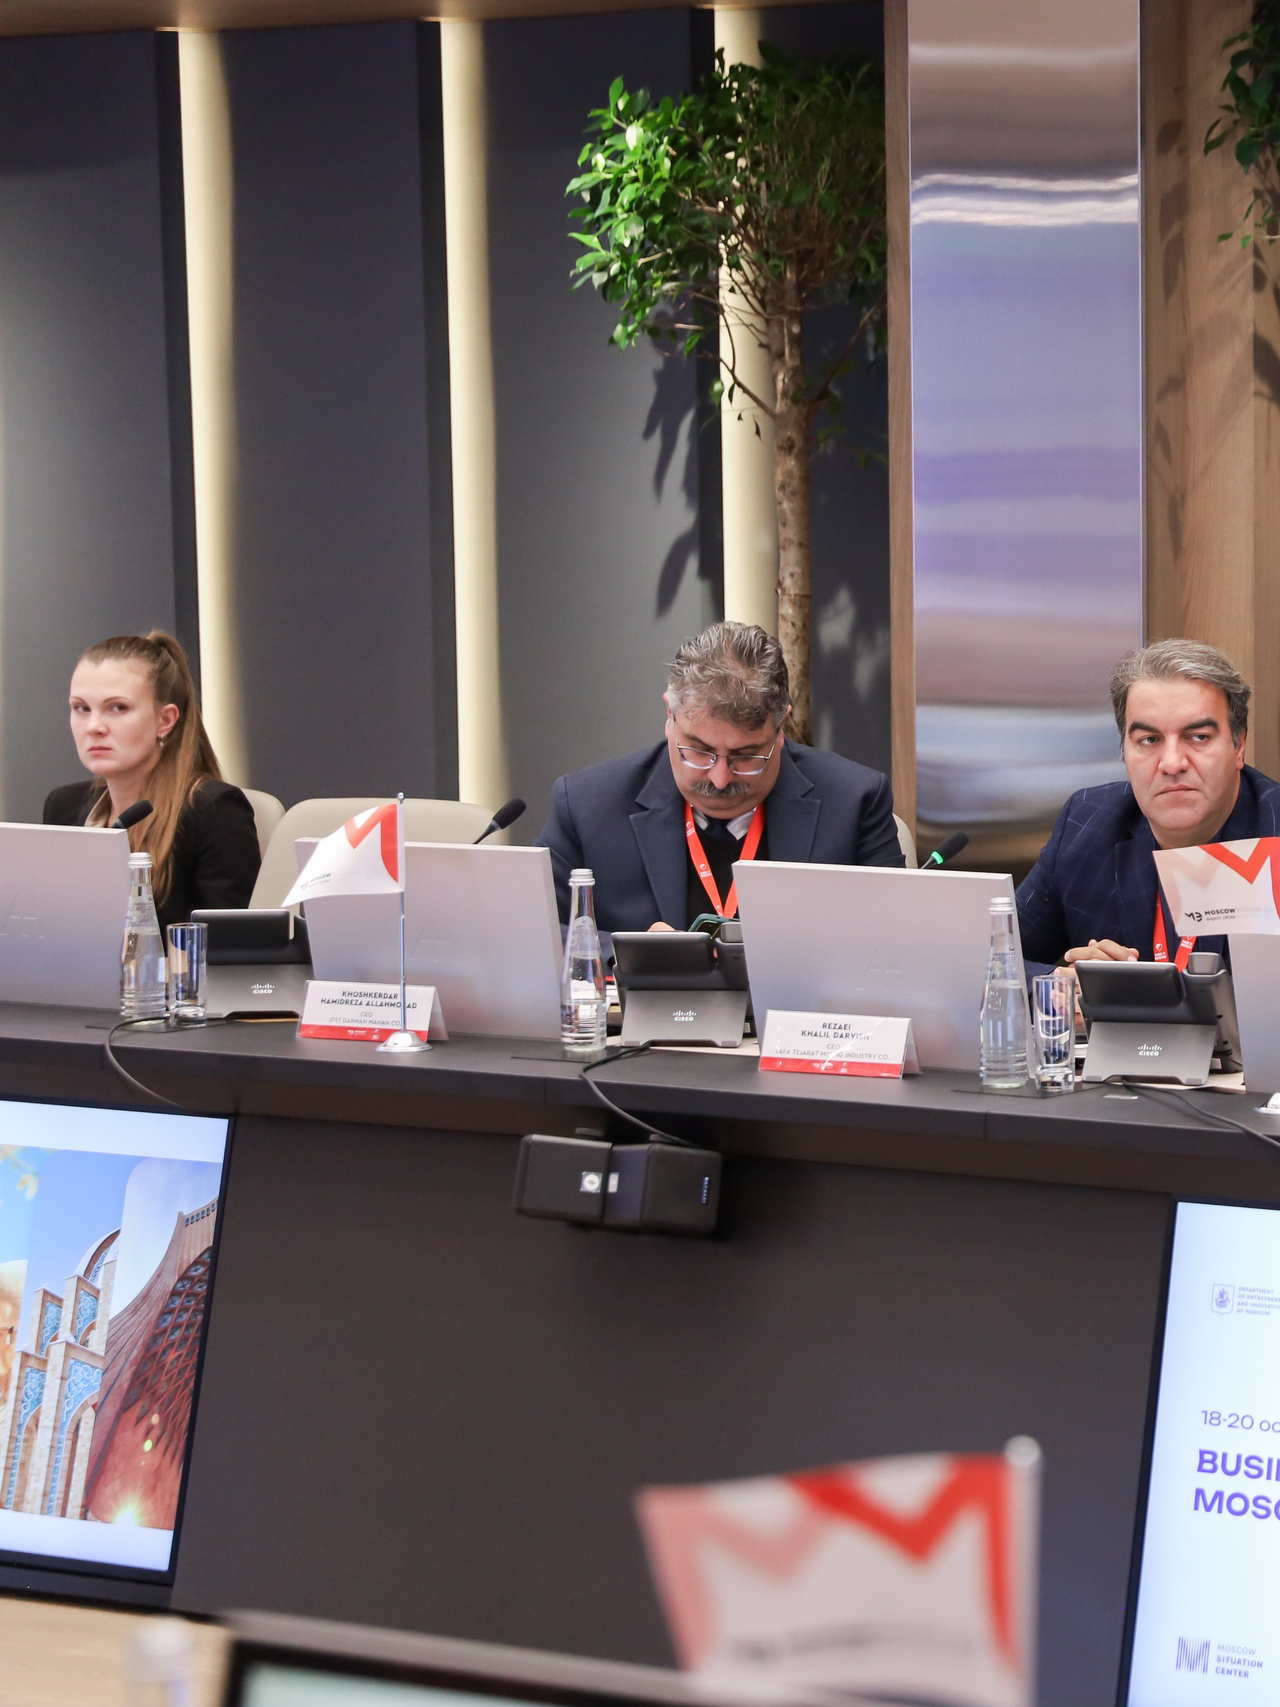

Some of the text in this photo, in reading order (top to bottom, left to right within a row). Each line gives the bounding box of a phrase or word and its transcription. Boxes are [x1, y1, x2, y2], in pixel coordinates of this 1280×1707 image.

[1204, 908, 1236, 916] MOSCOW
[342, 990, 398, 1000] KHOSHKERDAR
[320, 998, 418, 1009] HAMIDREZA ALLAHMOAD
[822, 1022, 852, 1030] REZAEI
[801, 1030, 830, 1038] KHALIL
[845, 1052, 876, 1060] INDUSTRY
[1238, 1286, 1274, 1294] DEPARTMENT
[1246, 1308, 1271, 1316] MOSCOW
[1200, 1410, 1254, 1430] 18-20
[1218, 1644, 1256, 1656] MOSCOW
[1216, 1655, 1264, 1668] SITUATION
[1215, 1666, 1250, 1678] CENTER
